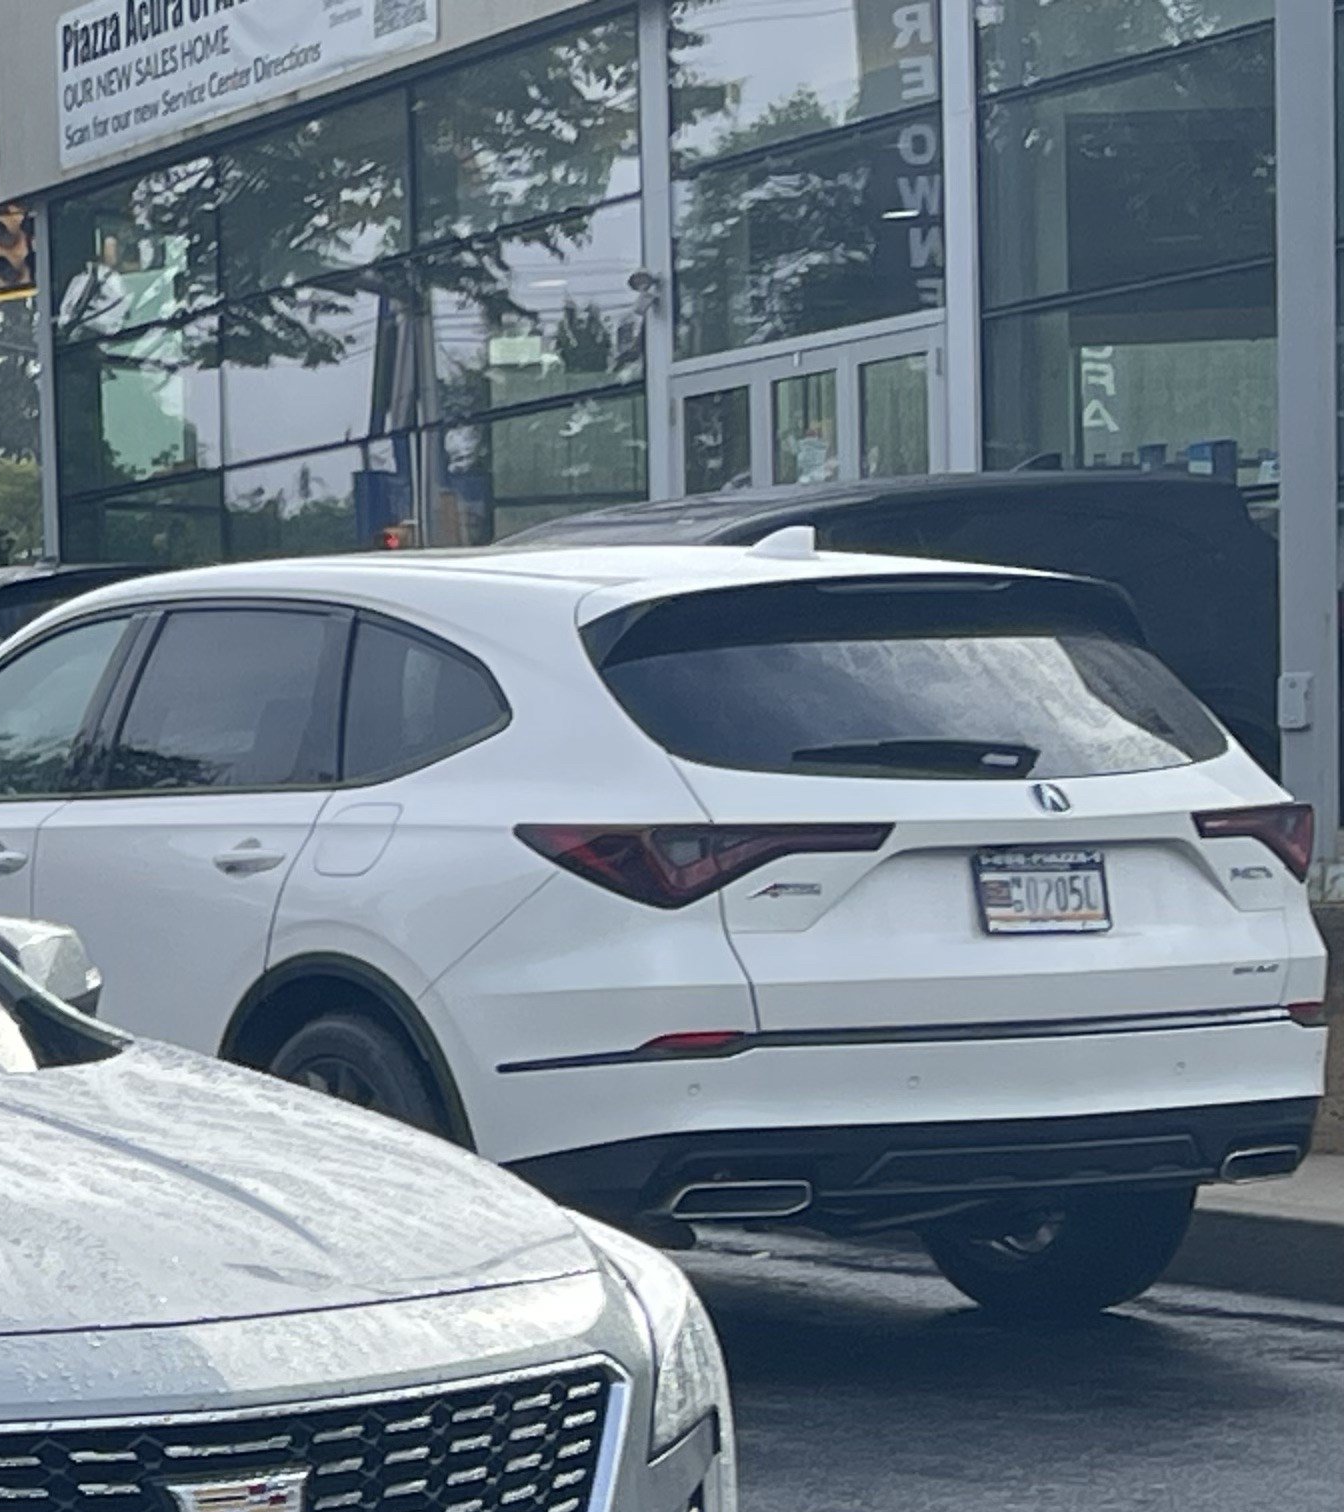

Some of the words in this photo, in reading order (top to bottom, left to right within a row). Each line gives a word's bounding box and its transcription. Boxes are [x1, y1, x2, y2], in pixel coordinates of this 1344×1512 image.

[62, 12, 120, 73] Piazza
[126, 0, 183, 47] Acura
[64, 77, 94, 112] OUR
[96, 62, 133, 100] NEW
[135, 44, 178, 87] SALES
[181, 25, 232, 70] HOME
[65, 122, 91, 150] Scan
[93, 115, 110, 140] for
[112, 109, 132, 133] our
[134, 101, 160, 126] new
[162, 81, 206, 116] Service
[208, 67, 252, 99] Center
[254, 41, 322, 84] Directions
